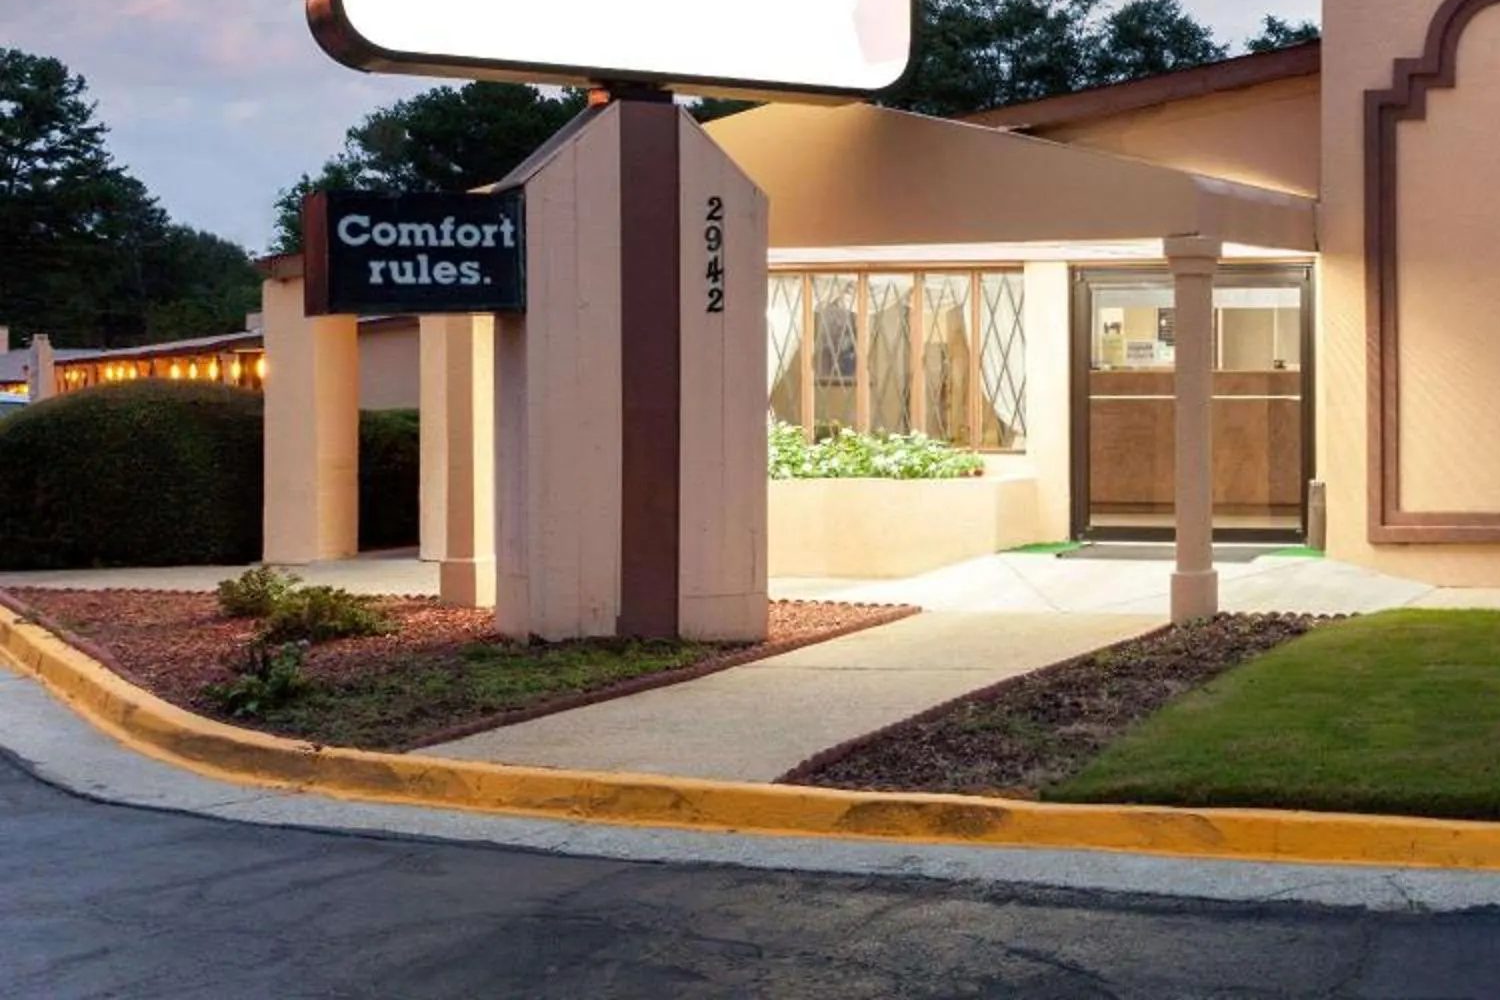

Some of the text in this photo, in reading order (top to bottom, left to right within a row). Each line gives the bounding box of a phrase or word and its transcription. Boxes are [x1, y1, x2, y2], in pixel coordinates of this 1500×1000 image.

[337, 214, 515, 247] Comfort
[368, 254, 493, 286] rules.
[703, 196, 724, 314] 2942
